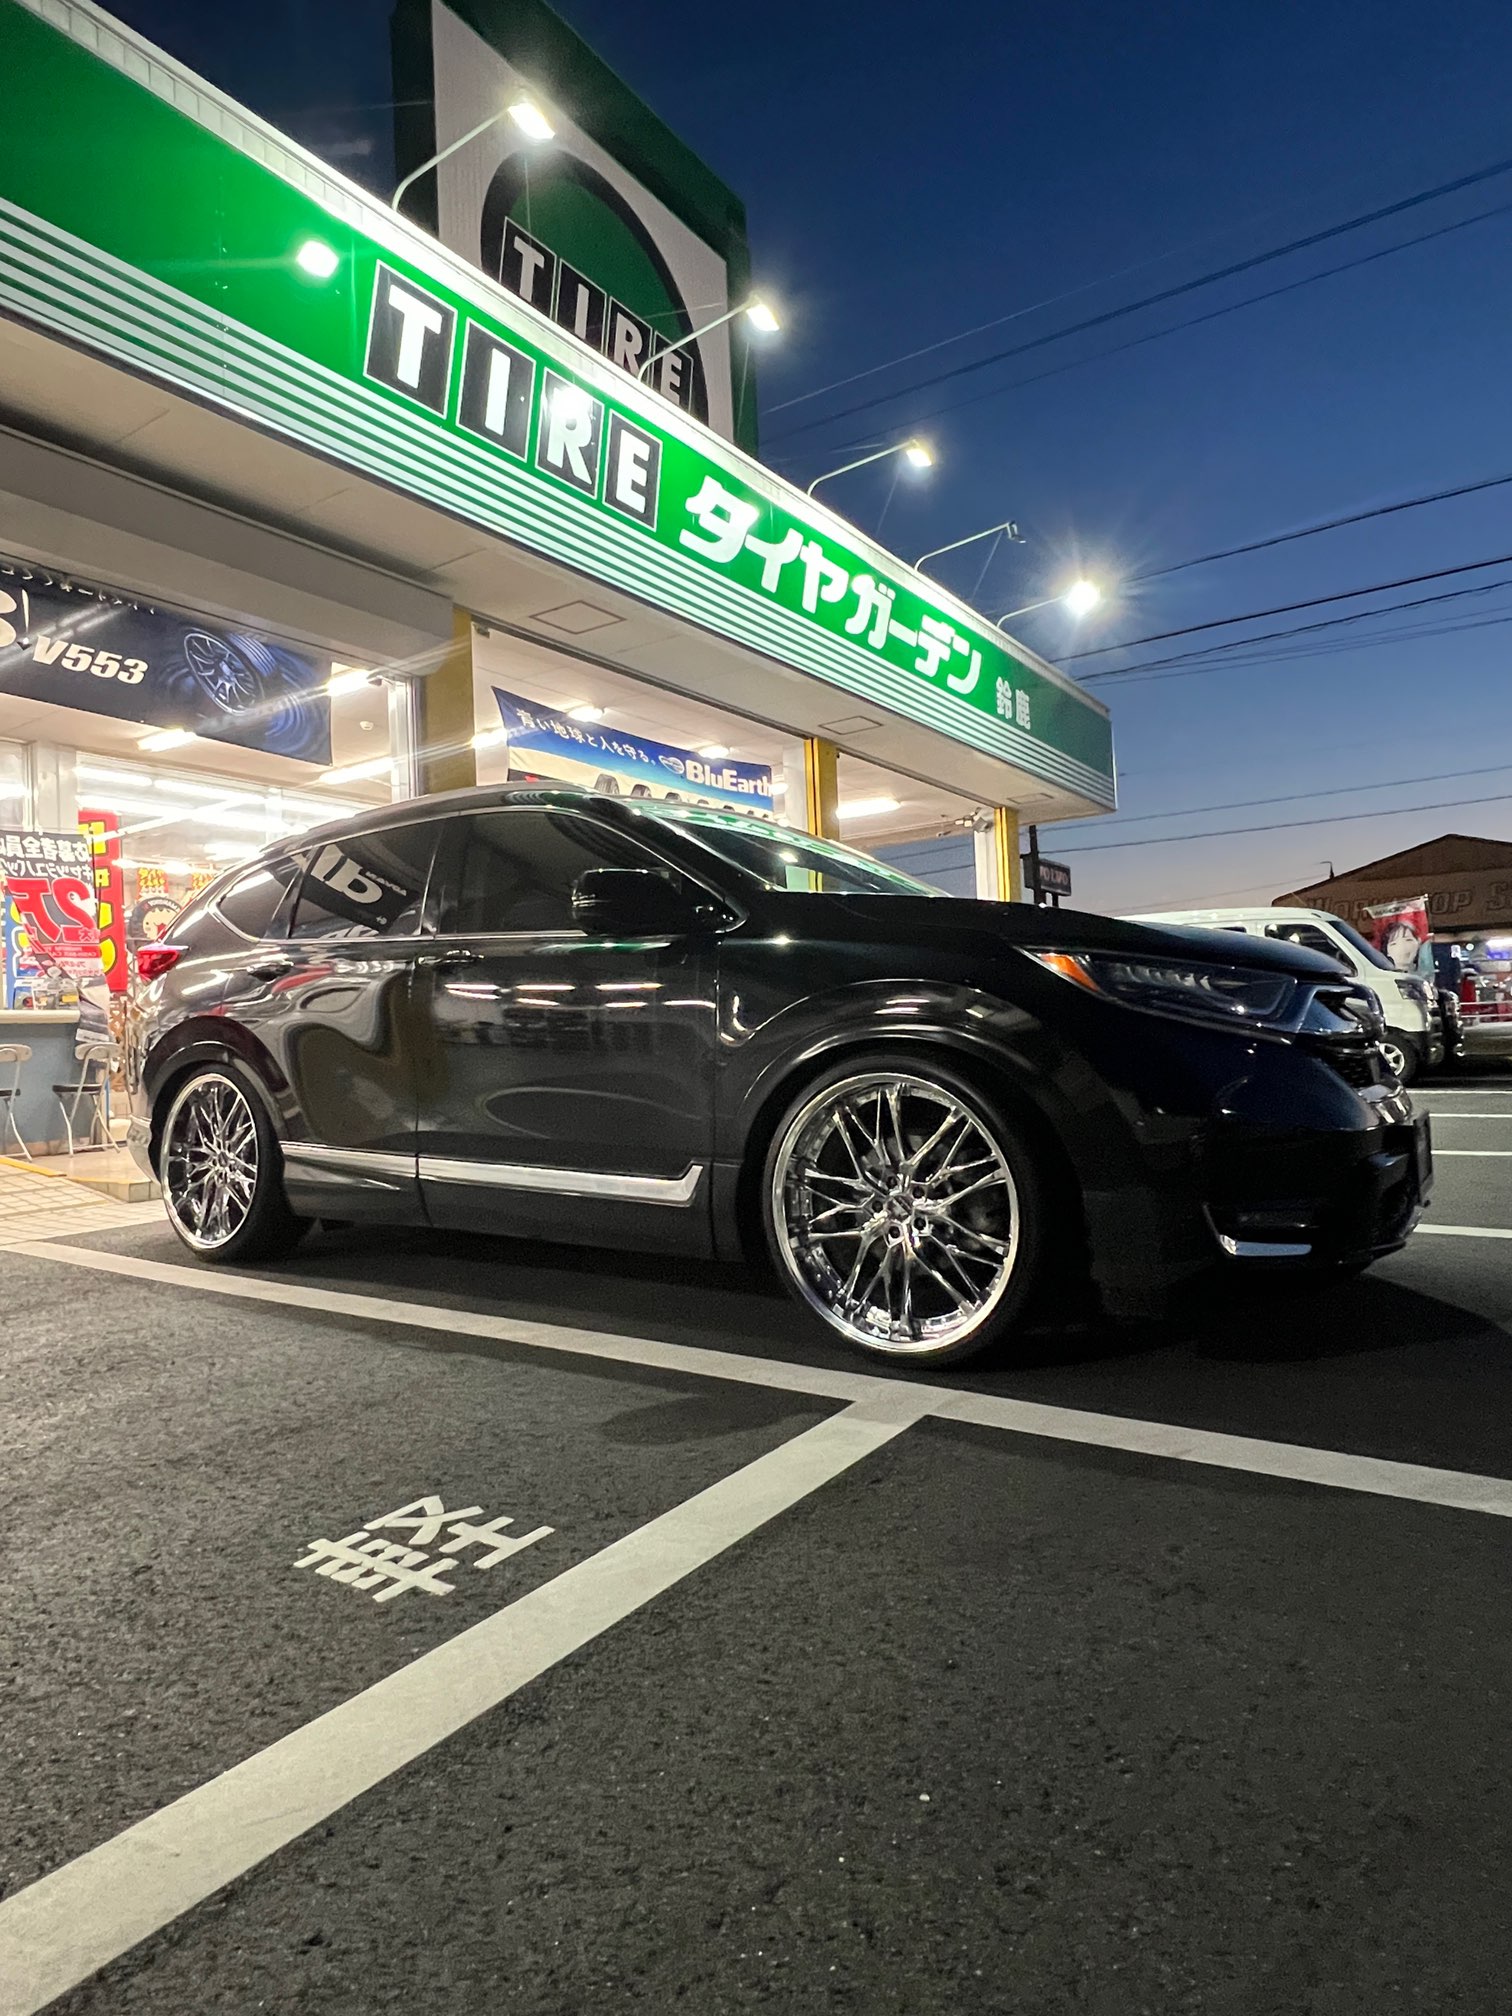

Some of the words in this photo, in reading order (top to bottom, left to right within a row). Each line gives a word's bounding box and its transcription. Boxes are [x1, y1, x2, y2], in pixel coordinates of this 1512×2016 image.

[388, 284, 650, 514] TIRE
[513, 235, 682, 406] TIRE
[32, 634, 149, 686] V553
[679, 475, 982, 694] タイヤガーデン
[685, 759, 773, 797] BluEarth
